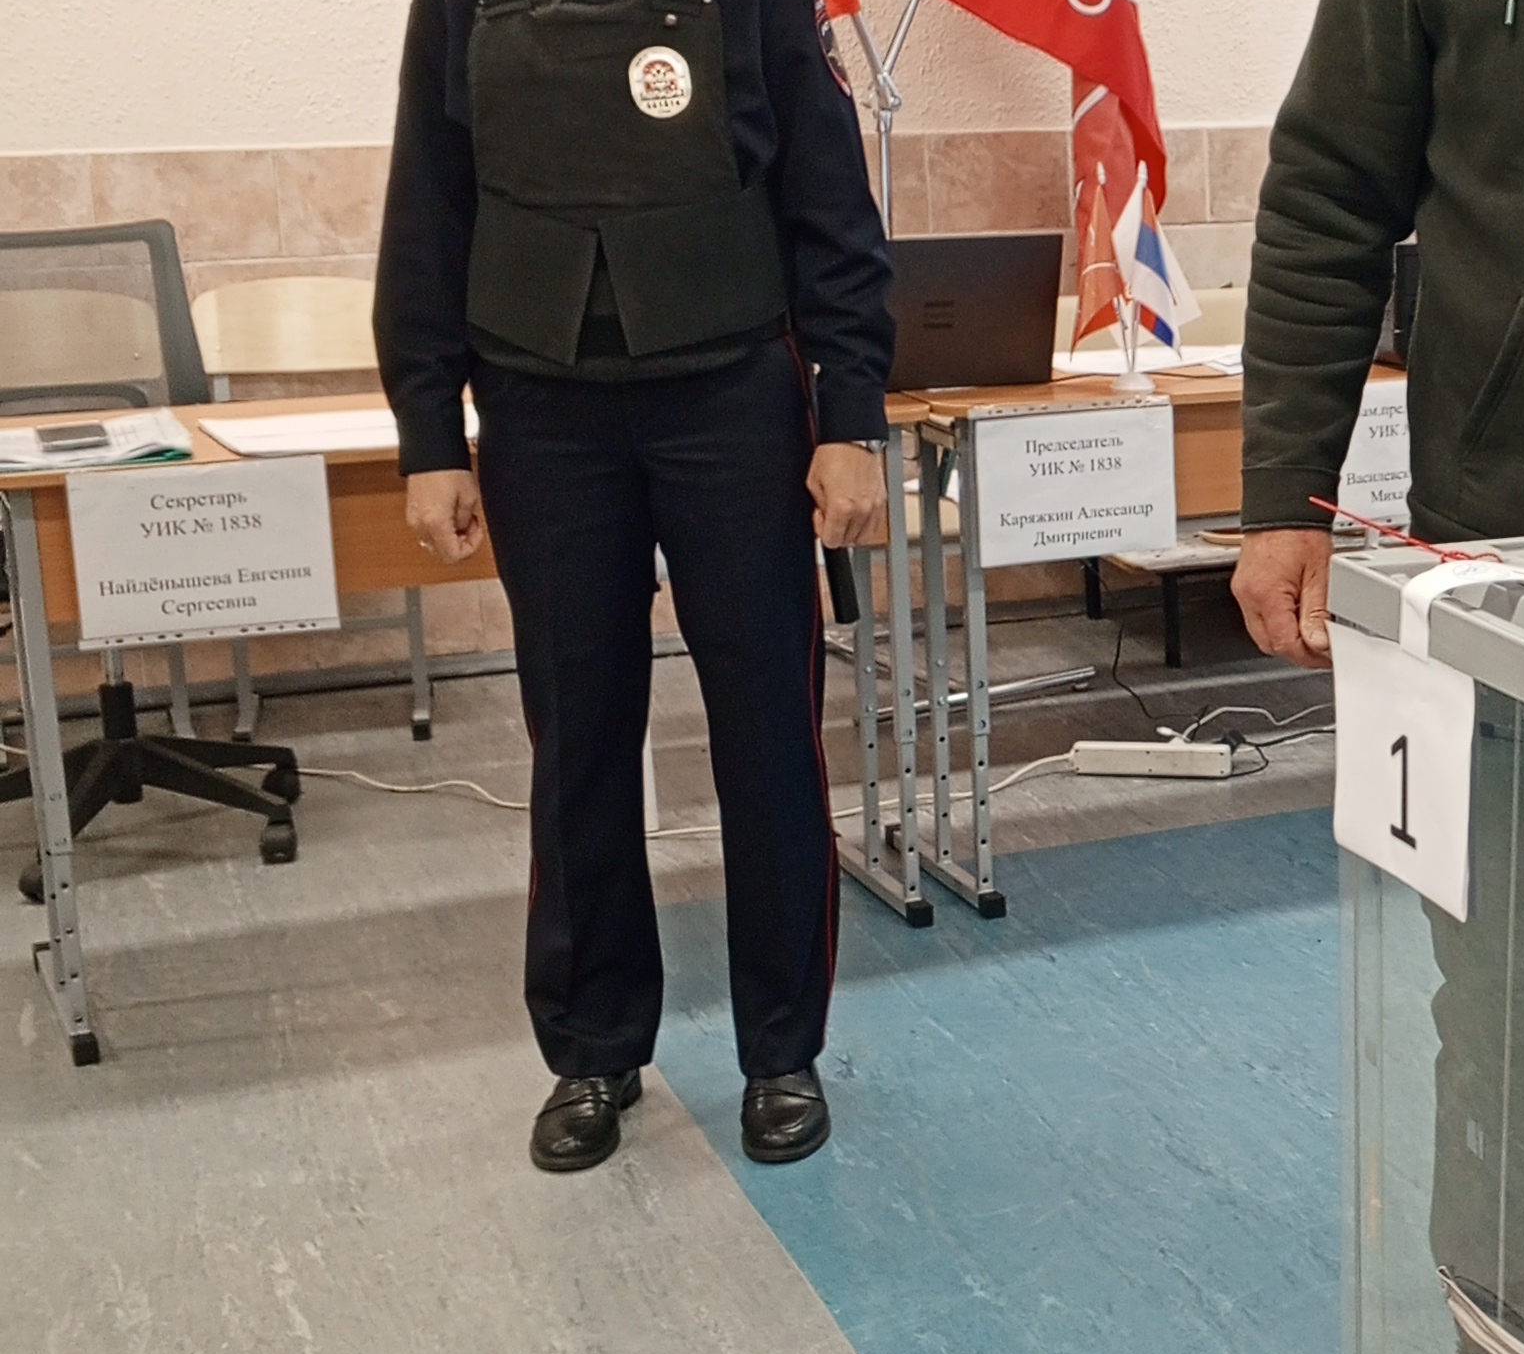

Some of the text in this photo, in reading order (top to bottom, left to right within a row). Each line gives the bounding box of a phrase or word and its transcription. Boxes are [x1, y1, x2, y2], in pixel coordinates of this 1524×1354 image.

[1369, 424, 1400, 439] УИК
[1026, 436, 1123, 456] Председатель
[1029, 457, 1122, 477] УИК № 1838
[150, 492, 247, 511] Секретарь
[1000, 502, 1153, 529] Каряжкин Александр
[140, 514, 262, 538] УИК № 1838
[1034, 527, 1122, 547] Дмитриевич
[99, 566, 312, 596] Найдёнышева Евгения
[161, 596, 257, 617] Сергеевна
[1390, 734, 1417, 850] 1
